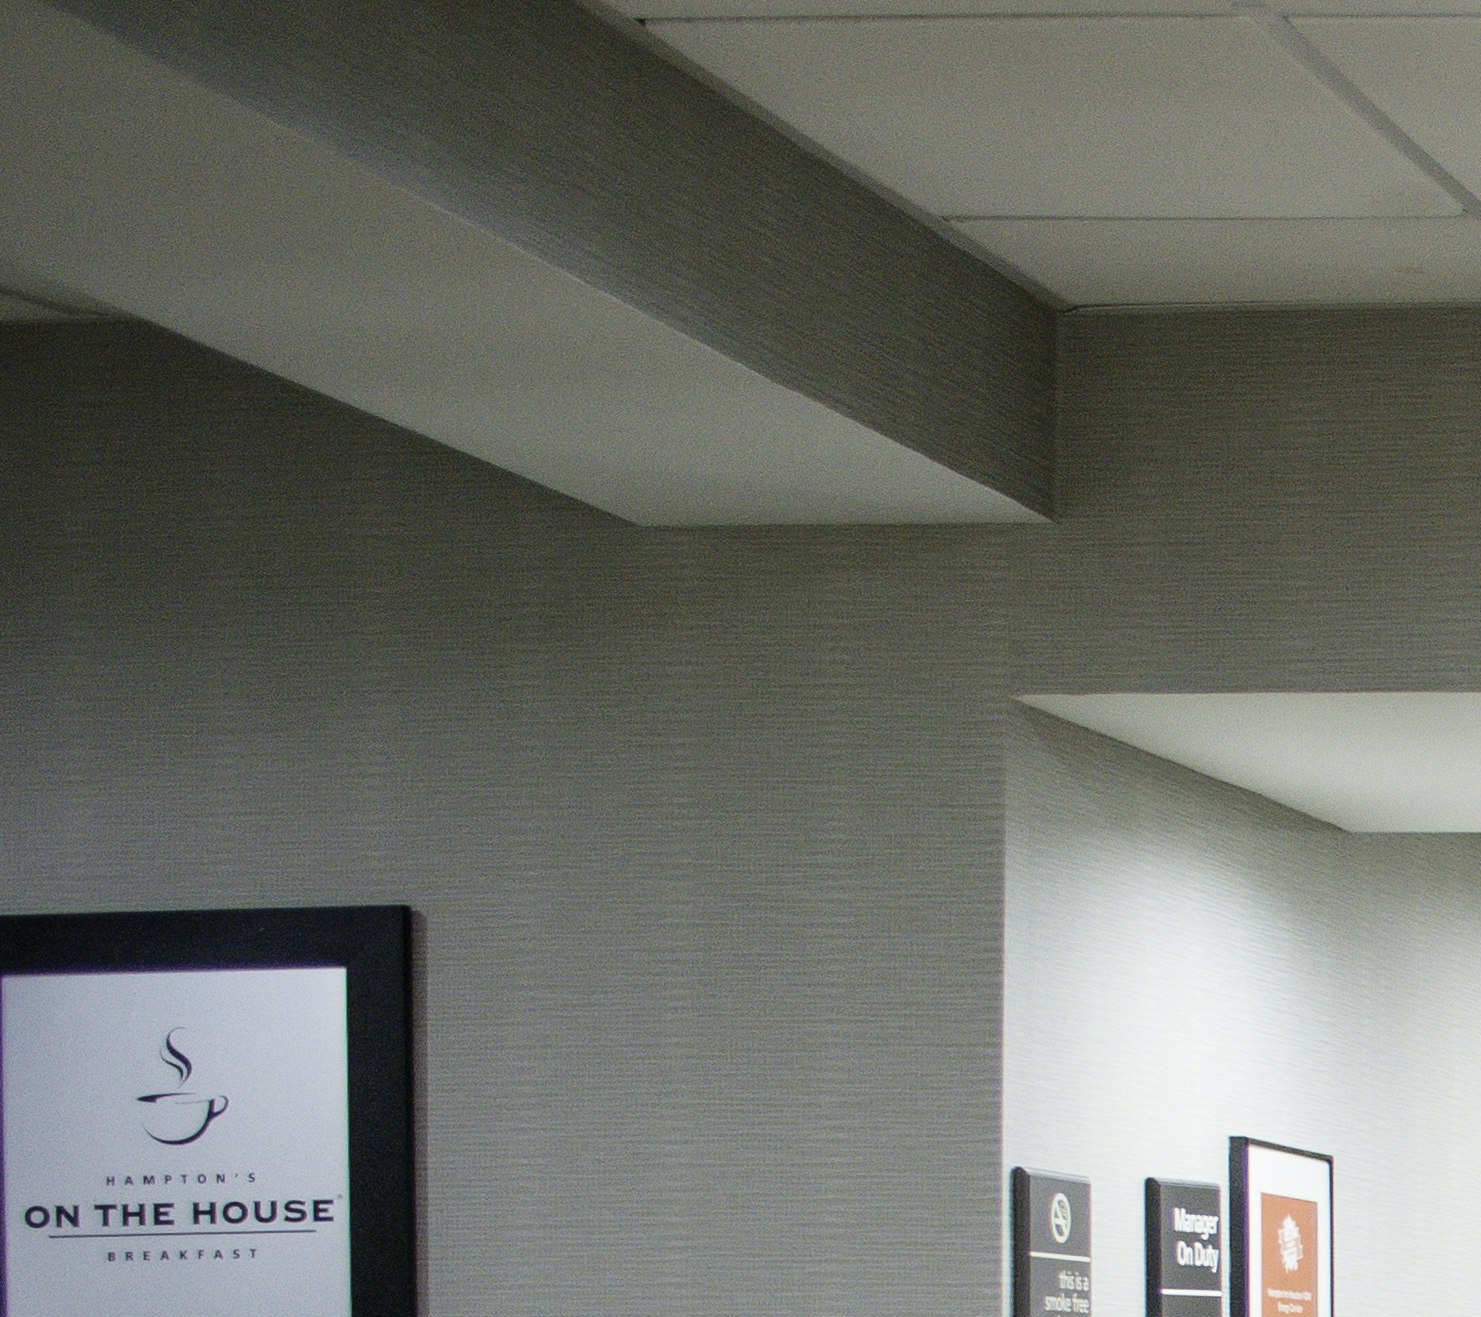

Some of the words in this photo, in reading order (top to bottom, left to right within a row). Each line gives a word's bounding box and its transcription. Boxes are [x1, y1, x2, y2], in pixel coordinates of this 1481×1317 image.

[105, 1172, 258, 1187] HAMPTON'S
[24, 1204, 80, 1229] ON
[94, 1202, 175, 1227] THE
[192, 1199, 335, 1225] HOUSE
[1174, 1207, 1219, 1240] Manager
[107, 1248, 259, 1262] BREAKFAST
[1177, 1240, 1193, 1267] On
[1194, 1242, 1219, 1273] Duty
[1059, 1270, 1074, 1290] this
[1082, 1276, 1089, 1291] a
[1045, 1293, 1071, 1312] smoke
[1072, 1293, 1089, 1313] free
